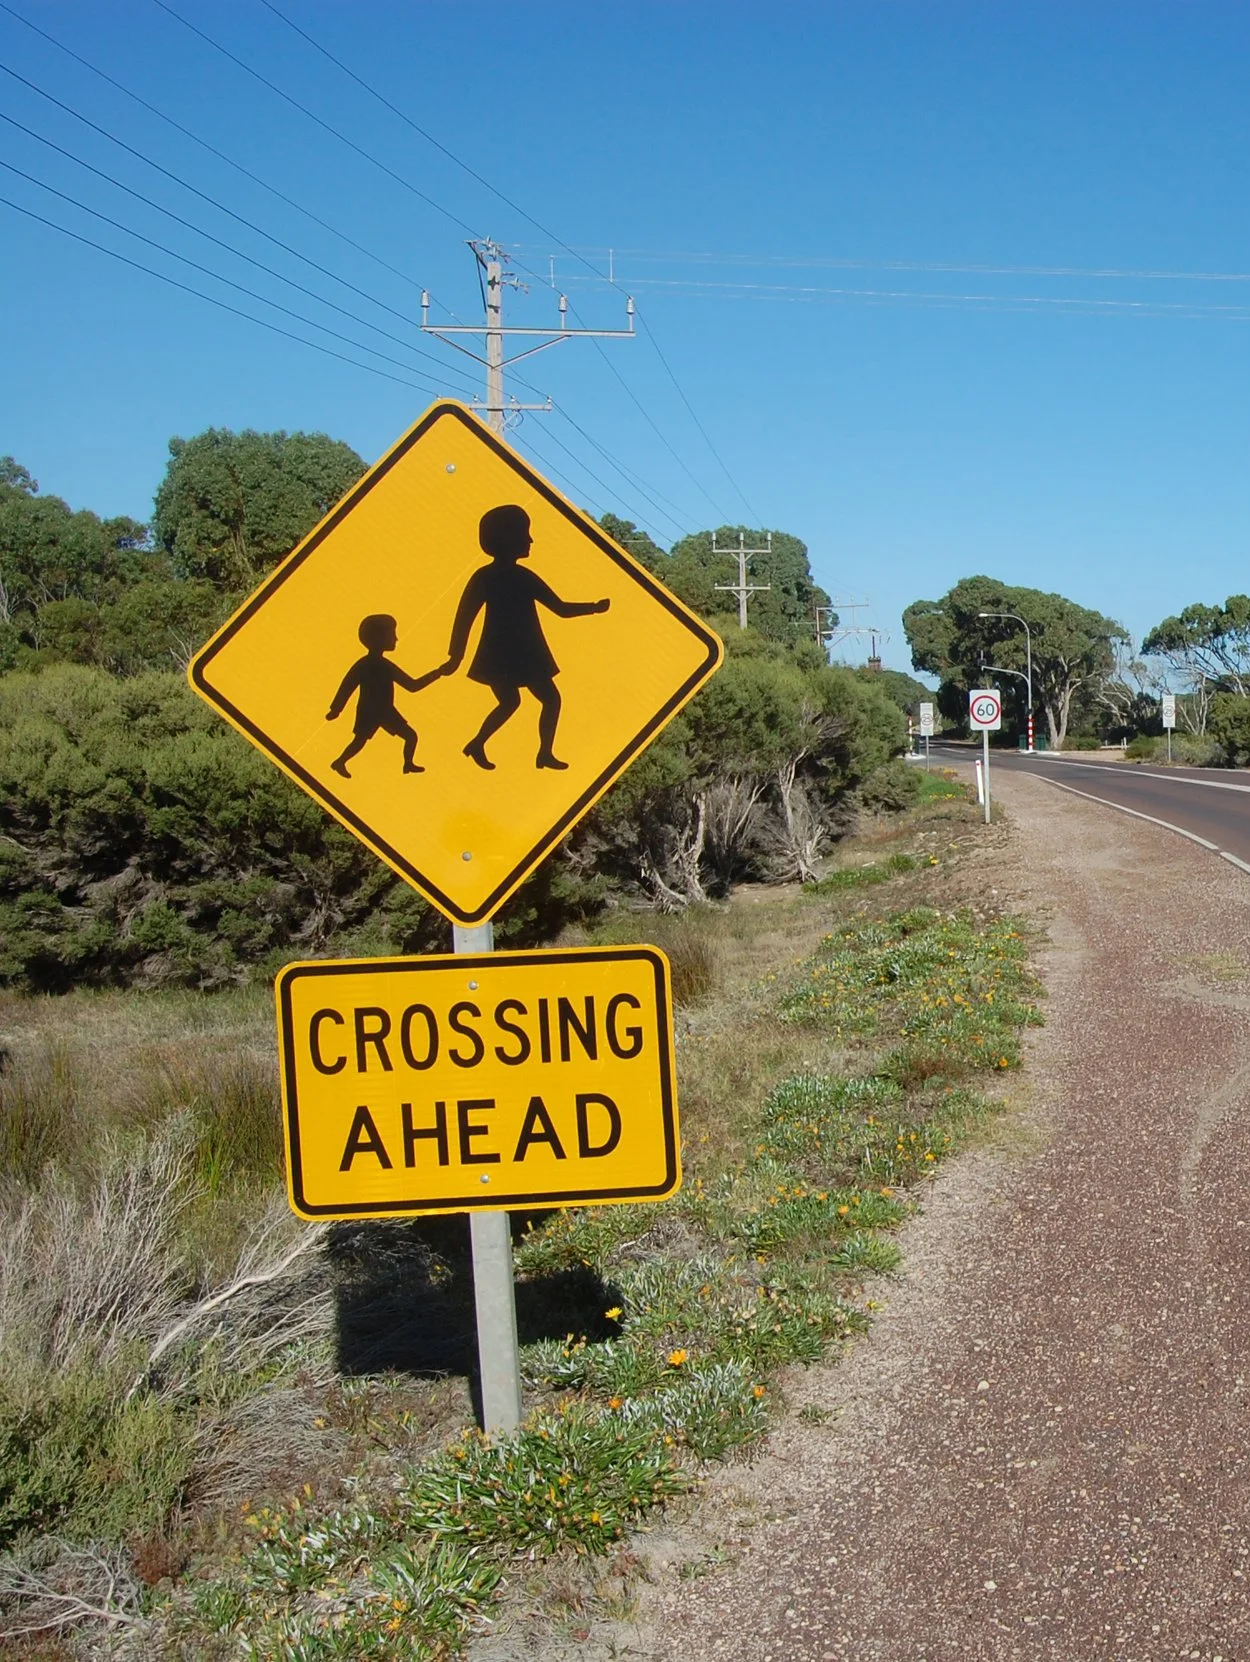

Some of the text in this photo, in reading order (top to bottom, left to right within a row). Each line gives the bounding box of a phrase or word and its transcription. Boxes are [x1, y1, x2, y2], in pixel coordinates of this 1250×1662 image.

[977, 703, 994, 717] 60
[309, 992, 643, 1076] CROSSING
[339, 1093, 622, 1172] AHEAD
